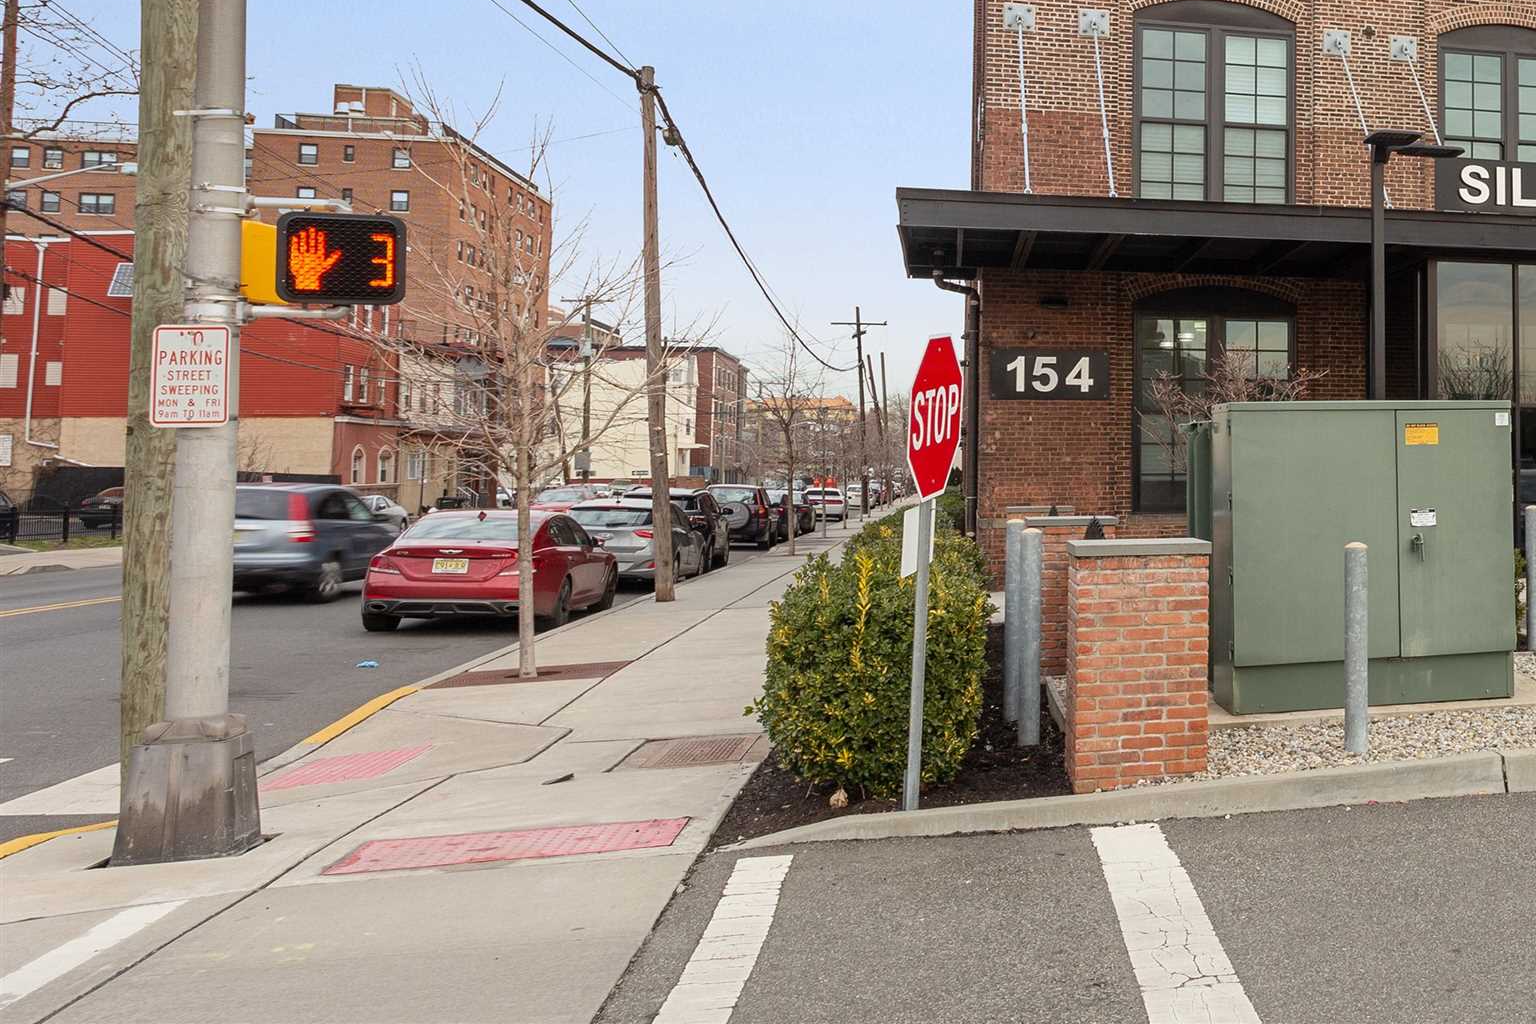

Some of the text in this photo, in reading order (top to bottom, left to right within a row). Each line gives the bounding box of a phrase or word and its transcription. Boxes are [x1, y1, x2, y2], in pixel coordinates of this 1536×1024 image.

[368, 232, 394, 288] 3
[159, 350, 222, 366] PARKING
[167, 370, 212, 381] STREET
[1006, 356, 1094, 393] 154
[160, 385, 219, 395] SWEEPING
[158, 399, 221, 407] MON & FRI
[158, 410, 177, 418] 9am
[183, 410, 195, 418] TO
[912, 384, 959, 451] STOP
